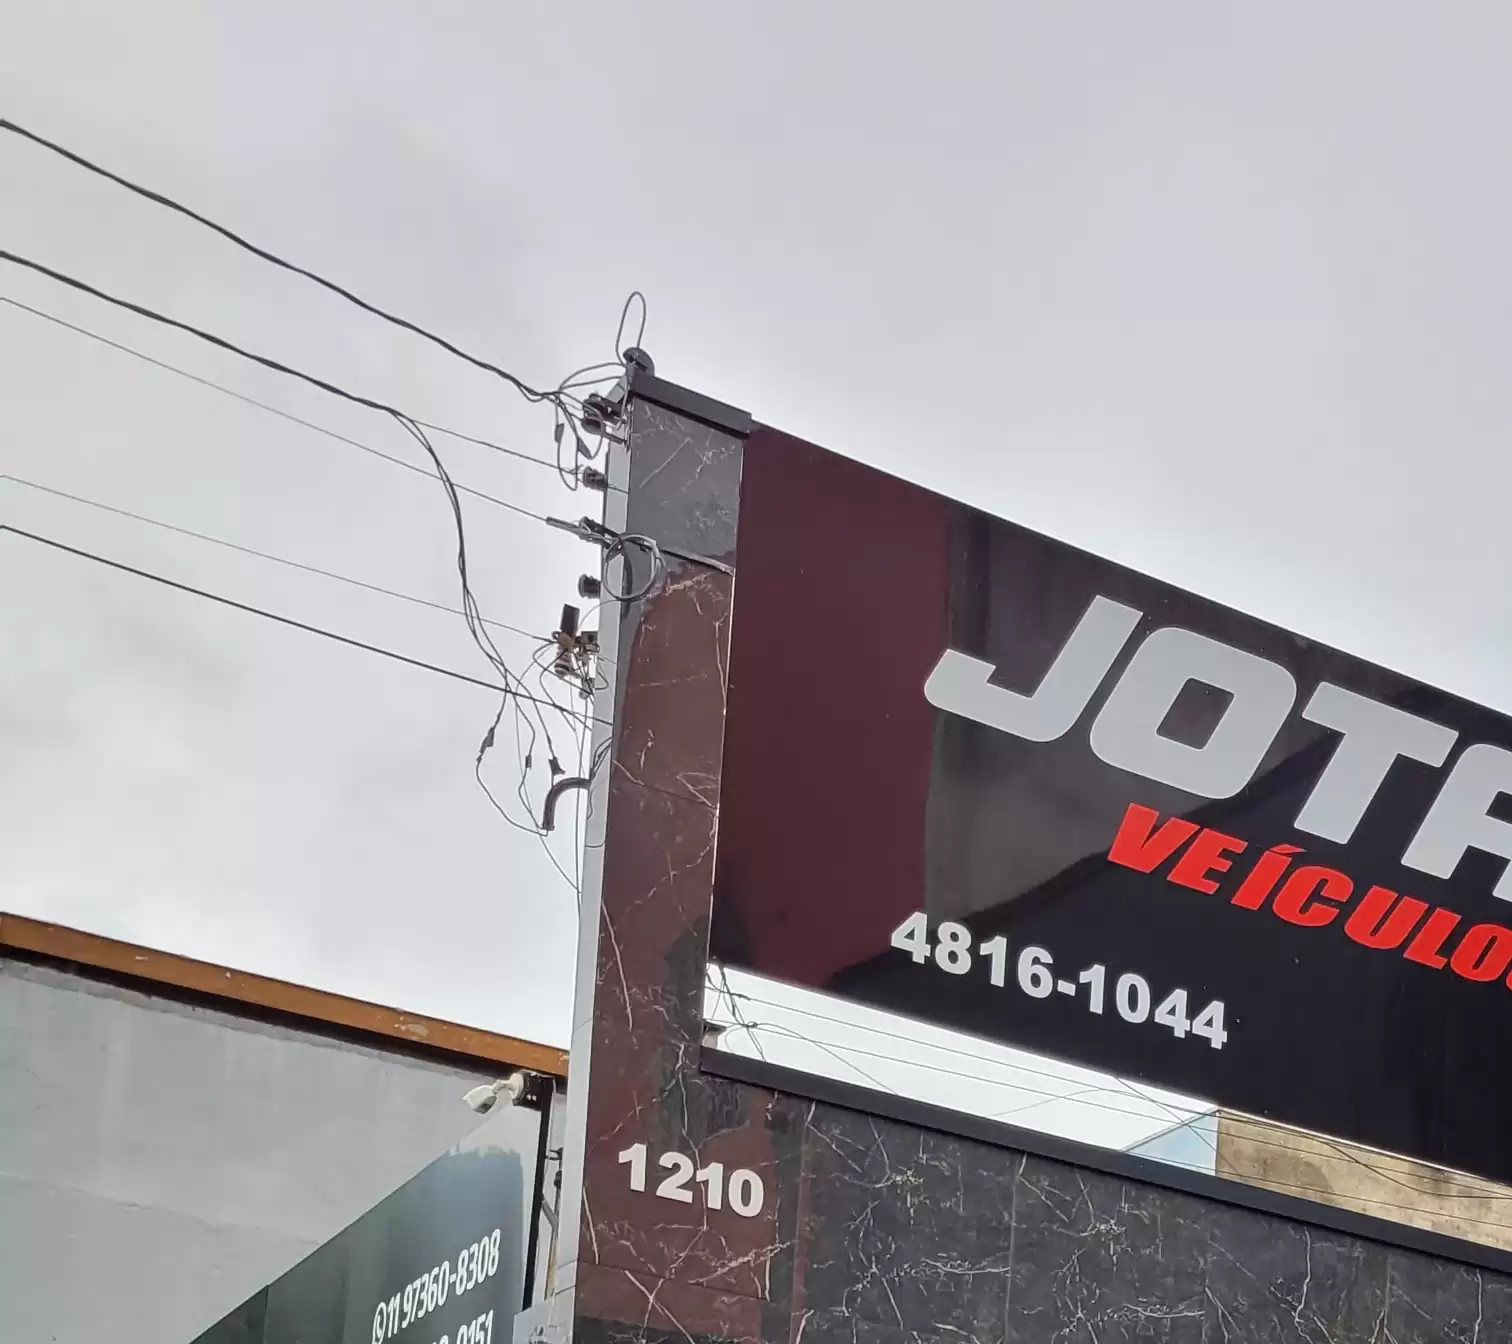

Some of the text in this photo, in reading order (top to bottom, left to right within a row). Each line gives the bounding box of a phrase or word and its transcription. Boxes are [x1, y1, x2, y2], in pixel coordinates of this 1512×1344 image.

[891, 911, 1228, 1049] 4816-1044
[618, 1142, 765, 1217] 1210
[387, 1228, 501, 1338] 11 97360-8308
